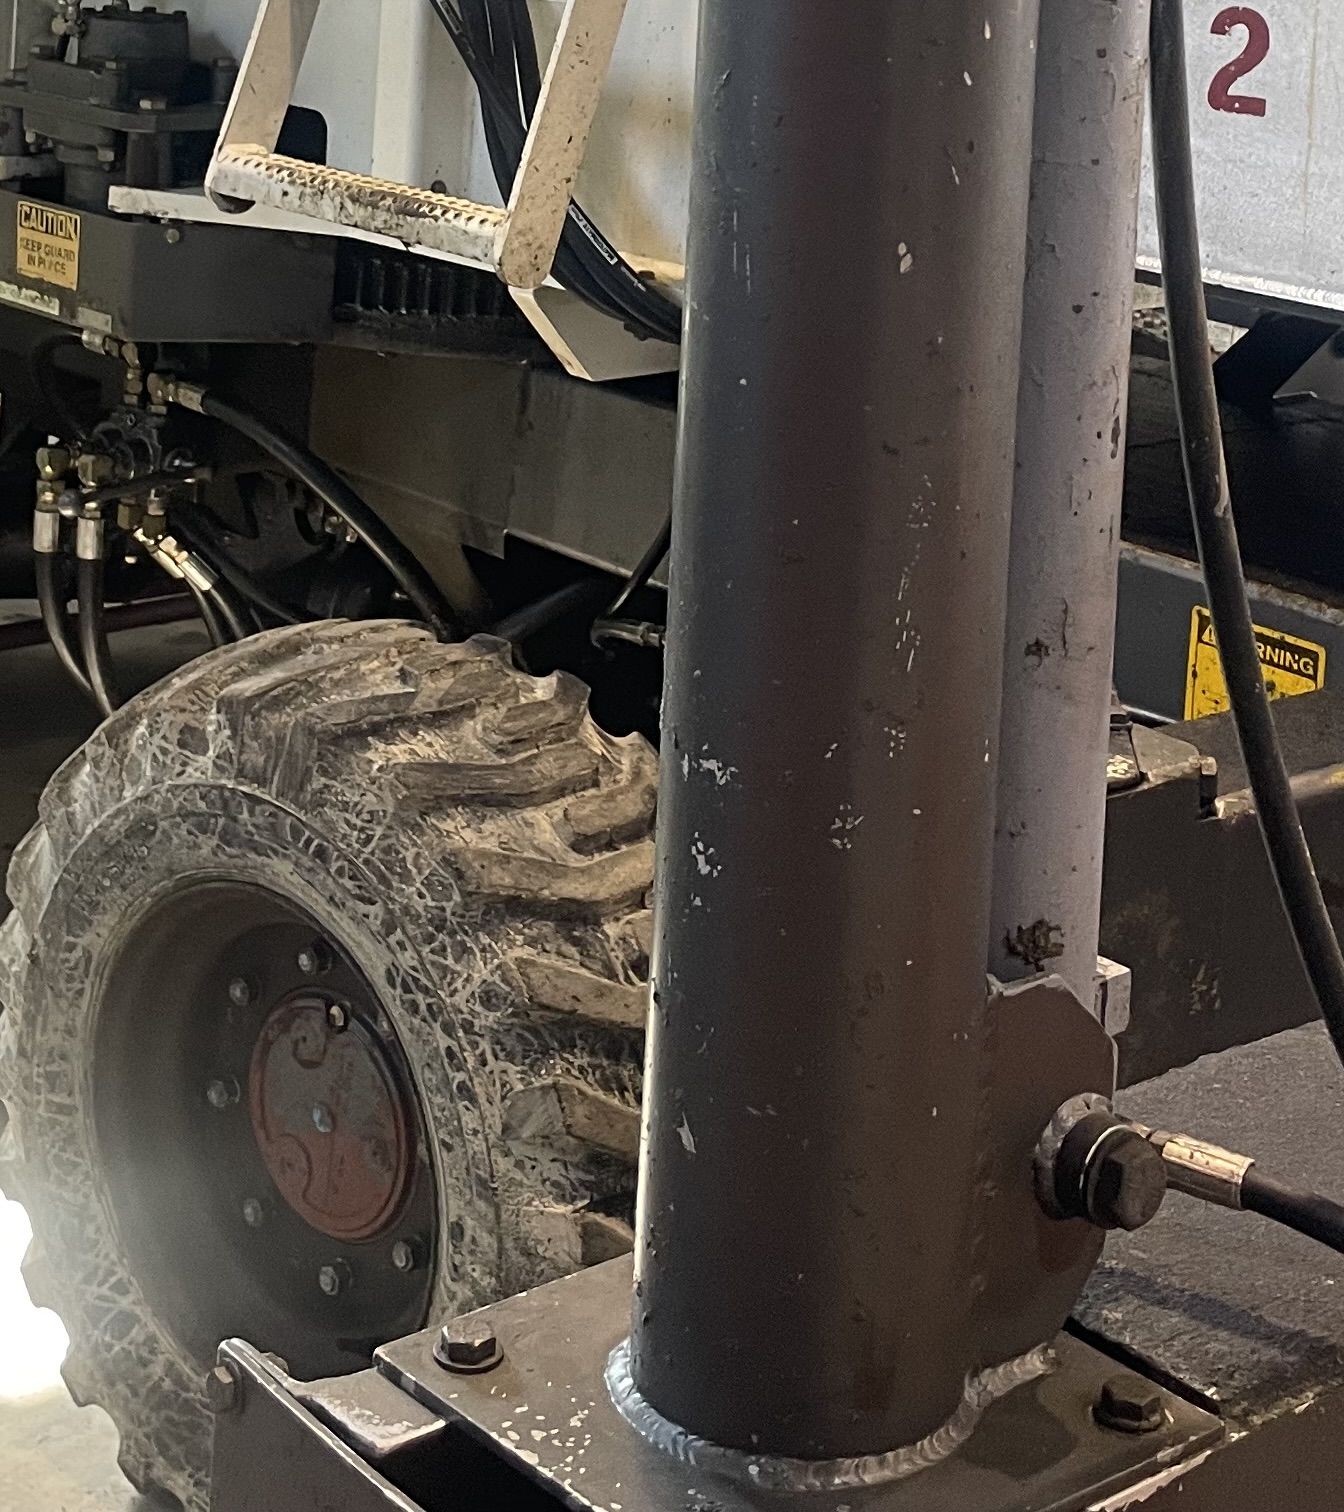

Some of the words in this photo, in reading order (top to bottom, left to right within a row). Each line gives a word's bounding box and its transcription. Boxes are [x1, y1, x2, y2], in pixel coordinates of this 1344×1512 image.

[1207, 6, 1270, 117] 2
[20, 205, 77, 241] CAUTION
[27, 253, 36, 267] IN
[44, 243, 75, 263] GUARD
[1256, 642, 1314, 676] RNING
